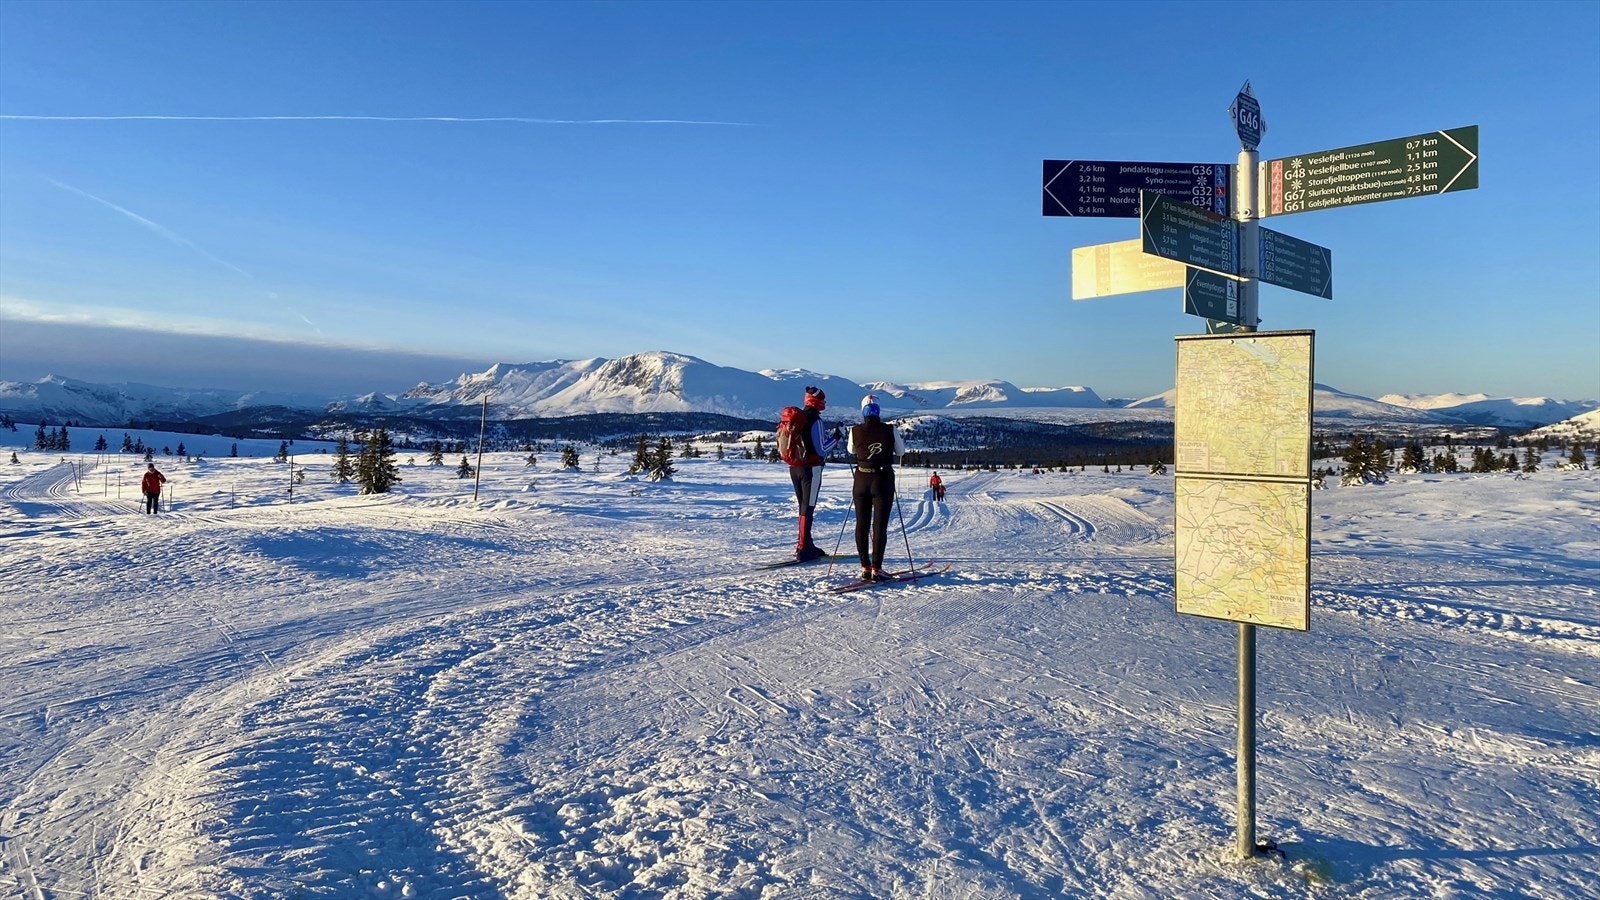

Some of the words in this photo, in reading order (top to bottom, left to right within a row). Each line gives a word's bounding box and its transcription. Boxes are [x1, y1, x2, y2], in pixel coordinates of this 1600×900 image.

[1232, 107, 1237, 119] S
[1239, 108, 1258, 130] G46
[1260, 119, 1266, 133] N
[1308, 152, 1345, 166] Veslefjell
[1406, 140, 1421, 150] 0,7
[1423, 138, 1438, 147] km
[1079, 165, 1091, 173] 2,6
[1120, 166, 1164, 175] Jondalstugu
[1192, 165, 1212, 176] G36
[1284, 168, 1306, 180] G48
[1308, 162, 1360, 176] Veslefjellbue
[1407, 152, 1420, 161] 1,1
[1423, 149, 1438, 158] km
[1079, 175, 1091, 183] 3,2
[1145, 177, 1164, 185] Syno
[1308, 172, 1371, 187] Storefjelltoppen
[1407, 163, 1421, 173] 2,5
[1423, 161, 1438, 170] km
[1192, 186, 1212, 196] G32
[1284, 189, 1306, 202] G67
[1308, 187, 1336, 198] Slurken
[1335, 179, 1381, 195] (Utsiktsbue)
[1407, 174, 1421, 184] 4,8
[1423, 172, 1438, 181] km
[1079, 196, 1091, 204] 4,2
[1192, 196, 1212, 206] G34
[1284, 200, 1305, 212] G61
[1308, 197, 1342, 208] Golsfjellet
[1342, 191, 1383, 204] alpinsenter
[1407, 186, 1421, 195] 7,5
[1423, 183, 1438, 192] km
[1078, 207, 1091, 215] 8,4
[1170, 203, 1178, 212] km
[1220, 217, 1231, 230] G45
[1162, 212, 1170, 221] 3,1
[1170, 214, 1178, 223] km
[1170, 225, 1178, 234] km
[1220, 228, 1231, 240] G41
[1162, 235, 1170, 244] 5,7
[1170, 236, 1178, 246] km
[1220, 239, 1231, 251] G31
[1170, 247, 1178, 257] km
